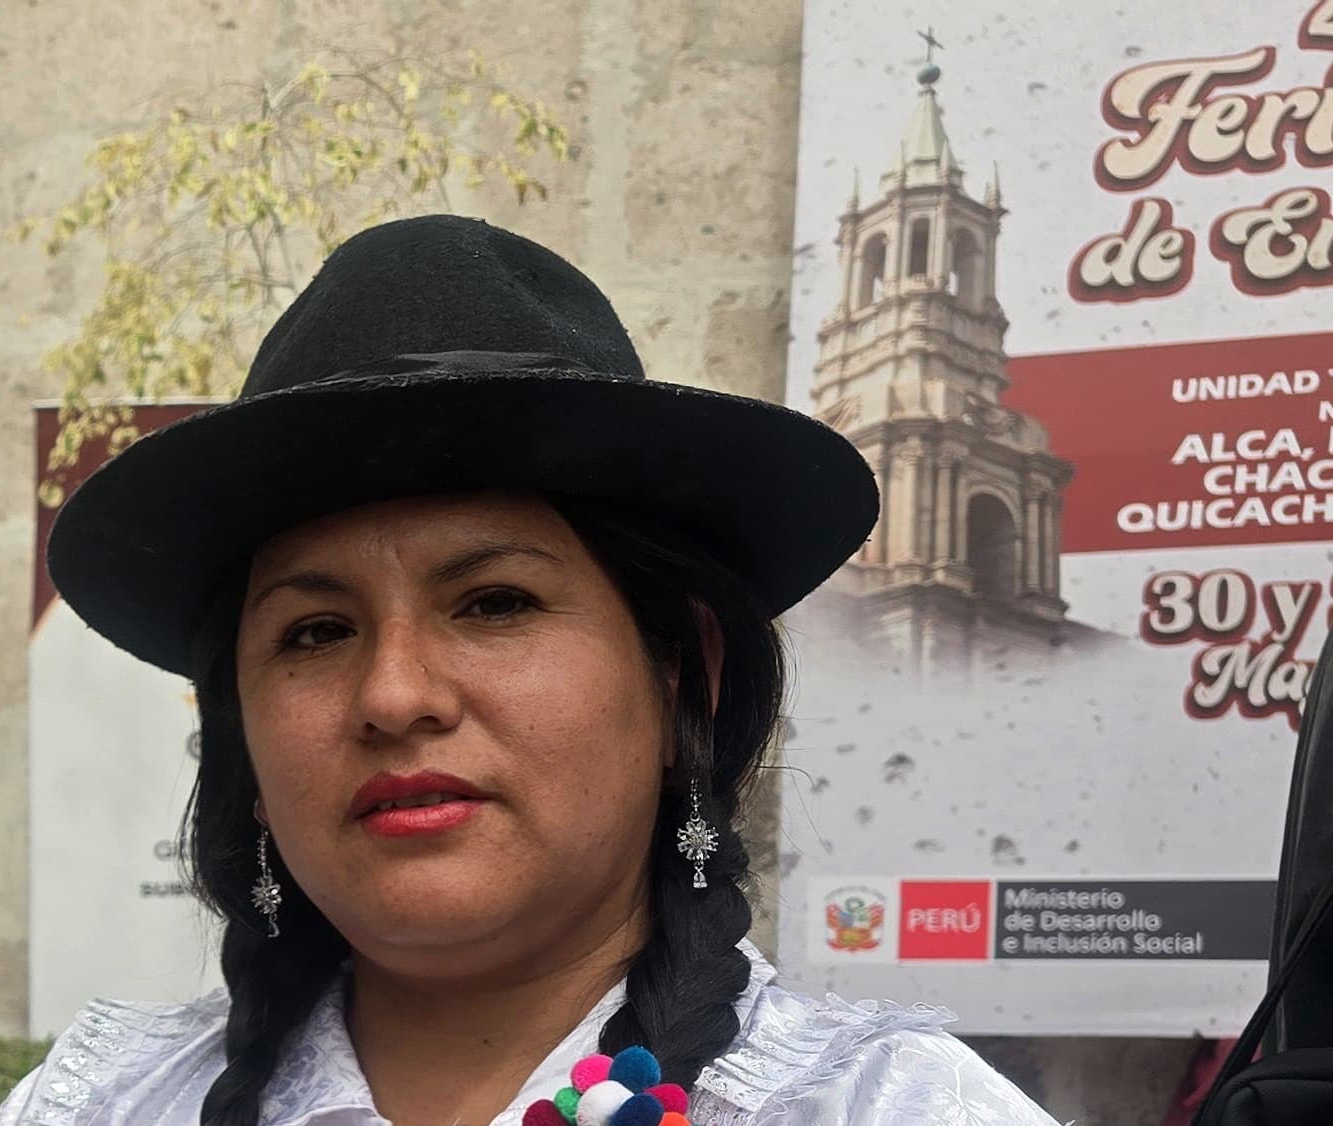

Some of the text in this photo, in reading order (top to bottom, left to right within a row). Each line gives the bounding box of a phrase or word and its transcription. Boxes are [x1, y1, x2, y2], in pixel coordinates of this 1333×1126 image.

[1077, 197, 1188, 290] de
[1171, 368, 1321, 403] UNIDAD
[1171, 428, 1315, 465] ALCA,
[1145, 570, 1314, 644] 30 y
[1003, 887, 1125, 909] Ministerio
[906, 902, 982, 933] PERÚ
[1003, 910, 1162, 932] de Desarrollo
[1002, 931, 1203, 954] e Inclusión Social
